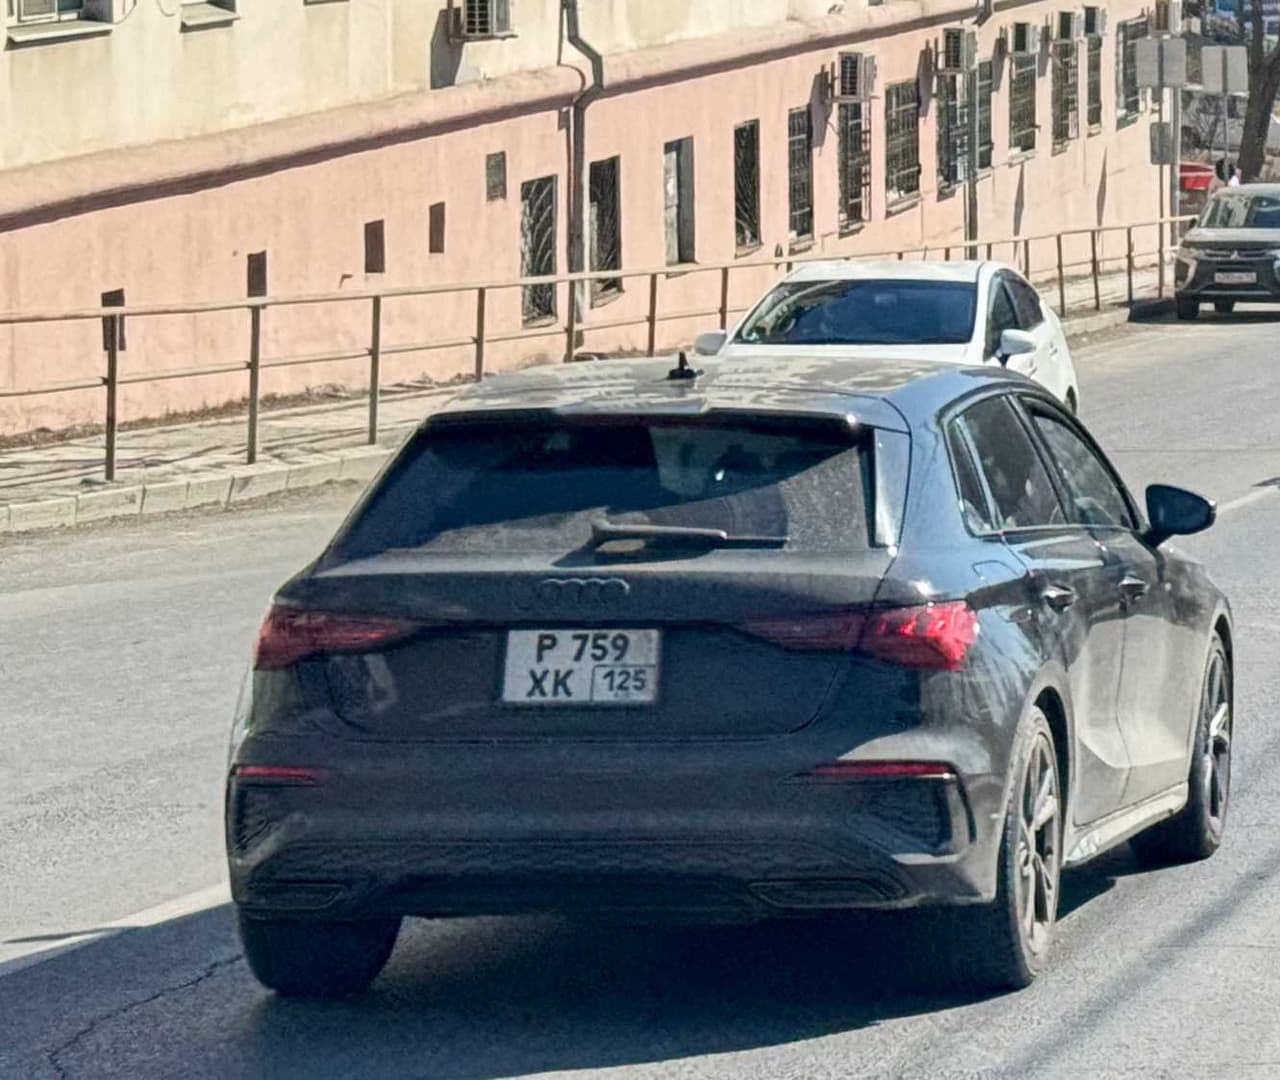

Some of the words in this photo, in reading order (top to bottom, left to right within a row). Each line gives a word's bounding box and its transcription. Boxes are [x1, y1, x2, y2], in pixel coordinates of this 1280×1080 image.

[572, 633, 630, 662] 759
[526, 669, 574, 698] ХК
[603, 670, 647, 692] 125
